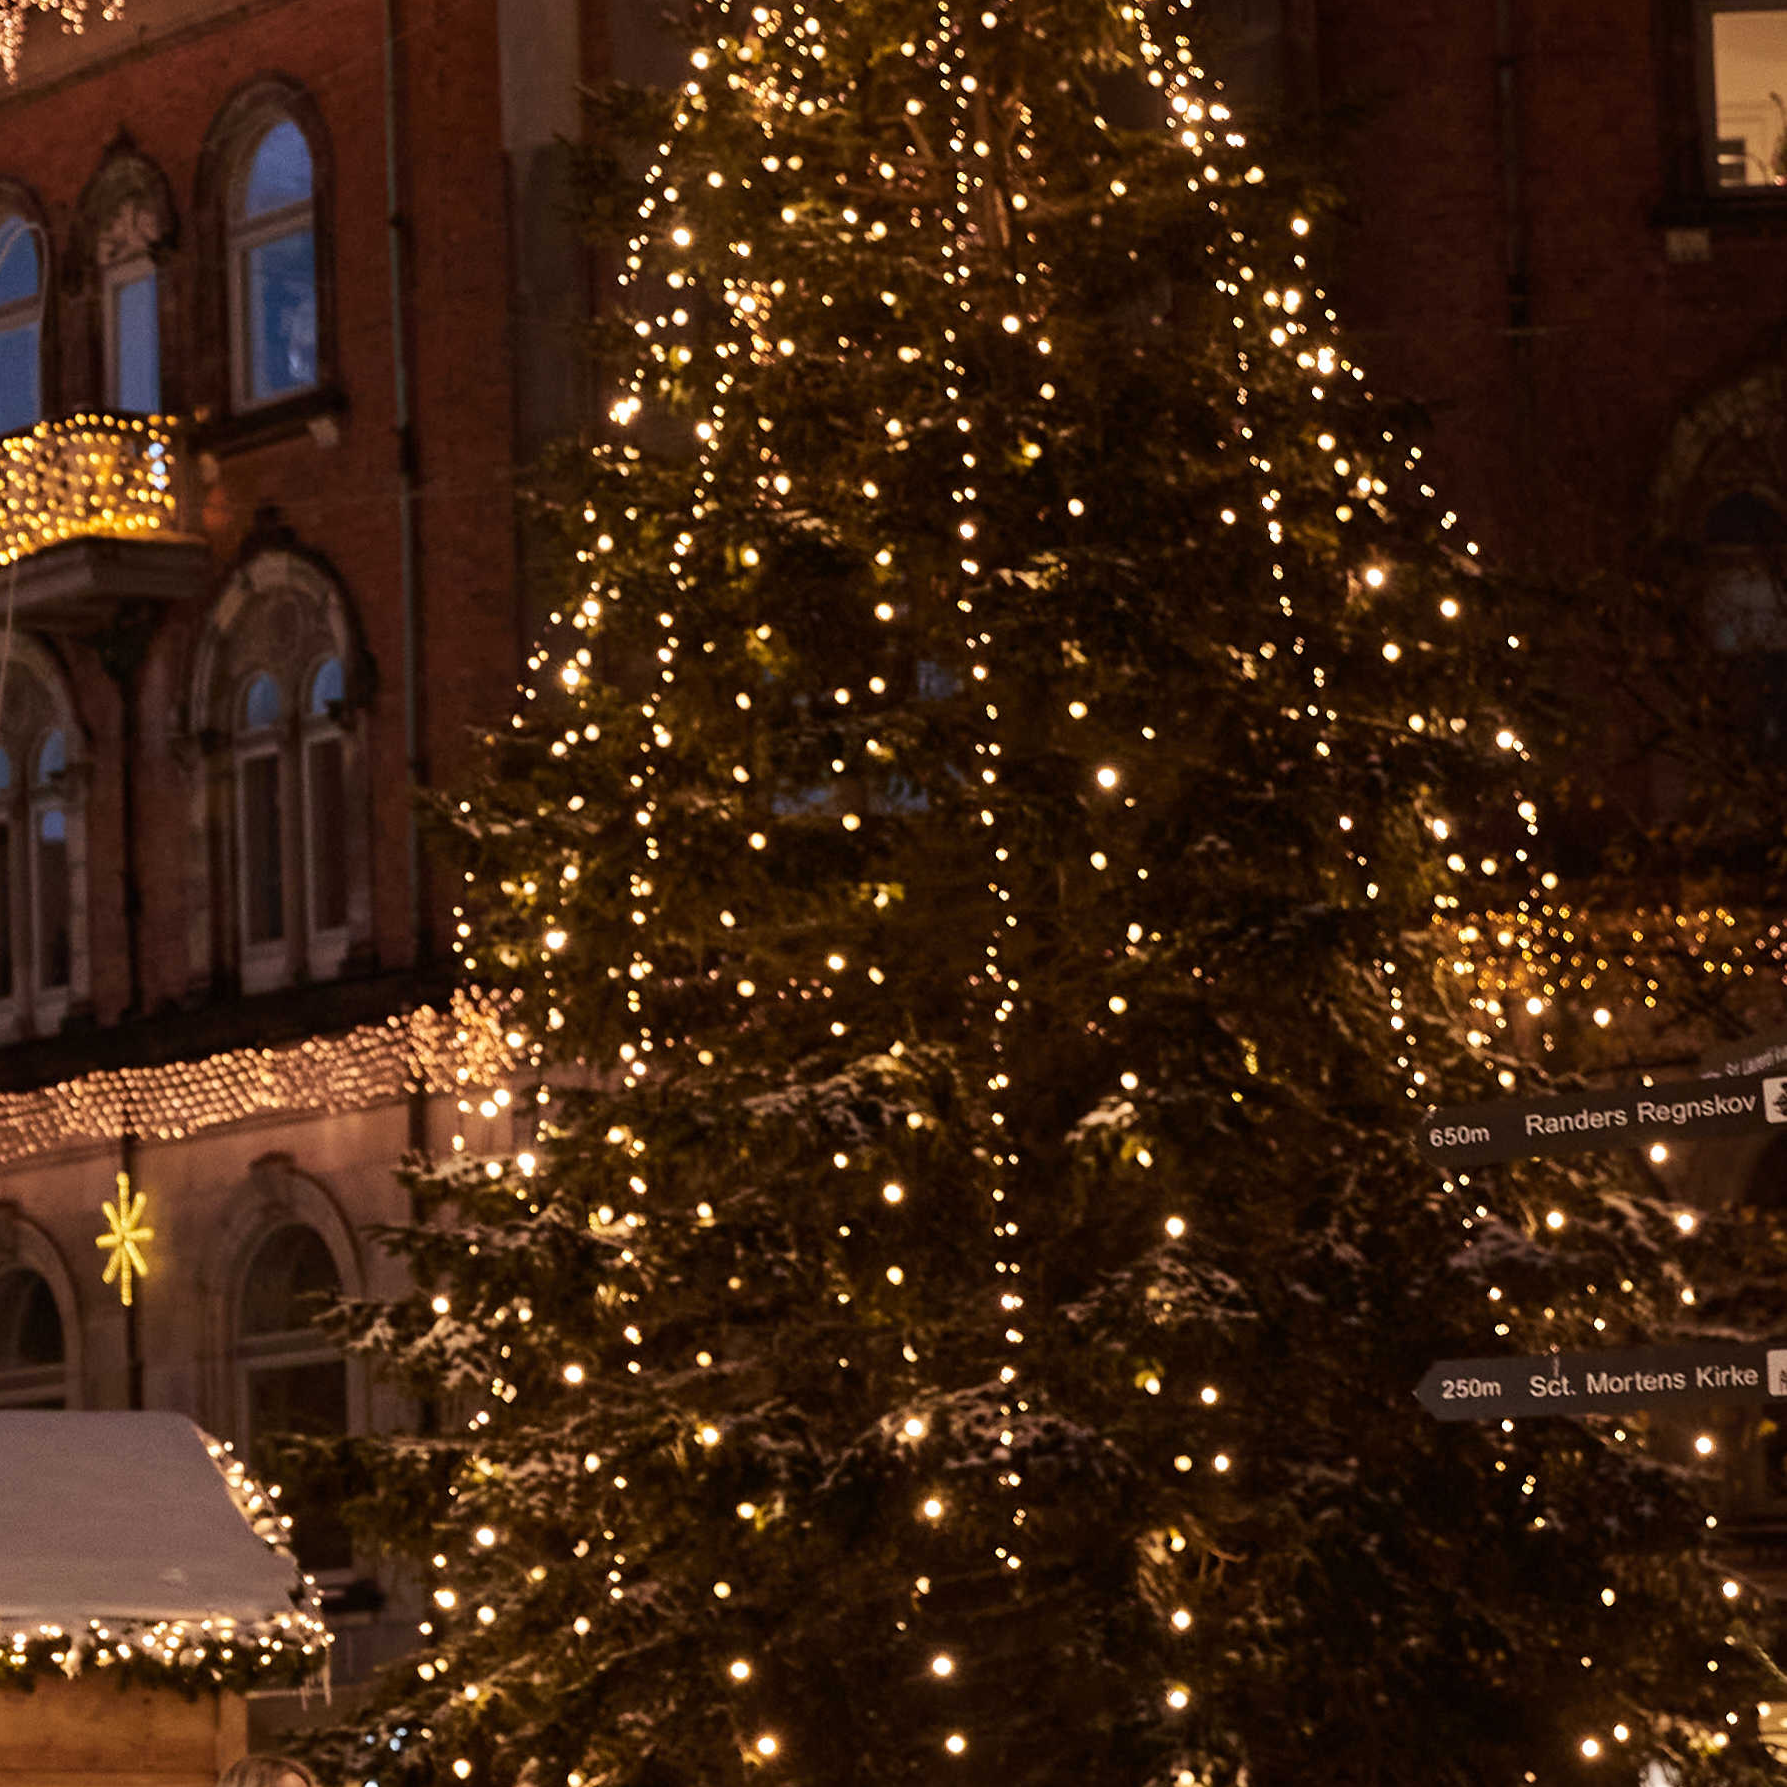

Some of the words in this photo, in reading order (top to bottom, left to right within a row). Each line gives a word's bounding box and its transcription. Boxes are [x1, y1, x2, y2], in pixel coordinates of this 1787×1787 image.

[1428, 1124, 1491, 1148] 650m
[1524, 1107, 1629, 1137] Randers
[1637, 1093, 1757, 1126] Regnskov
[1440, 1377, 1502, 1400] 250m
[1528, 1374, 1577, 1399] Sct.
[1586, 1368, 1686, 1396] Mortens
[1695, 1364, 1759, 1389] Kirke
